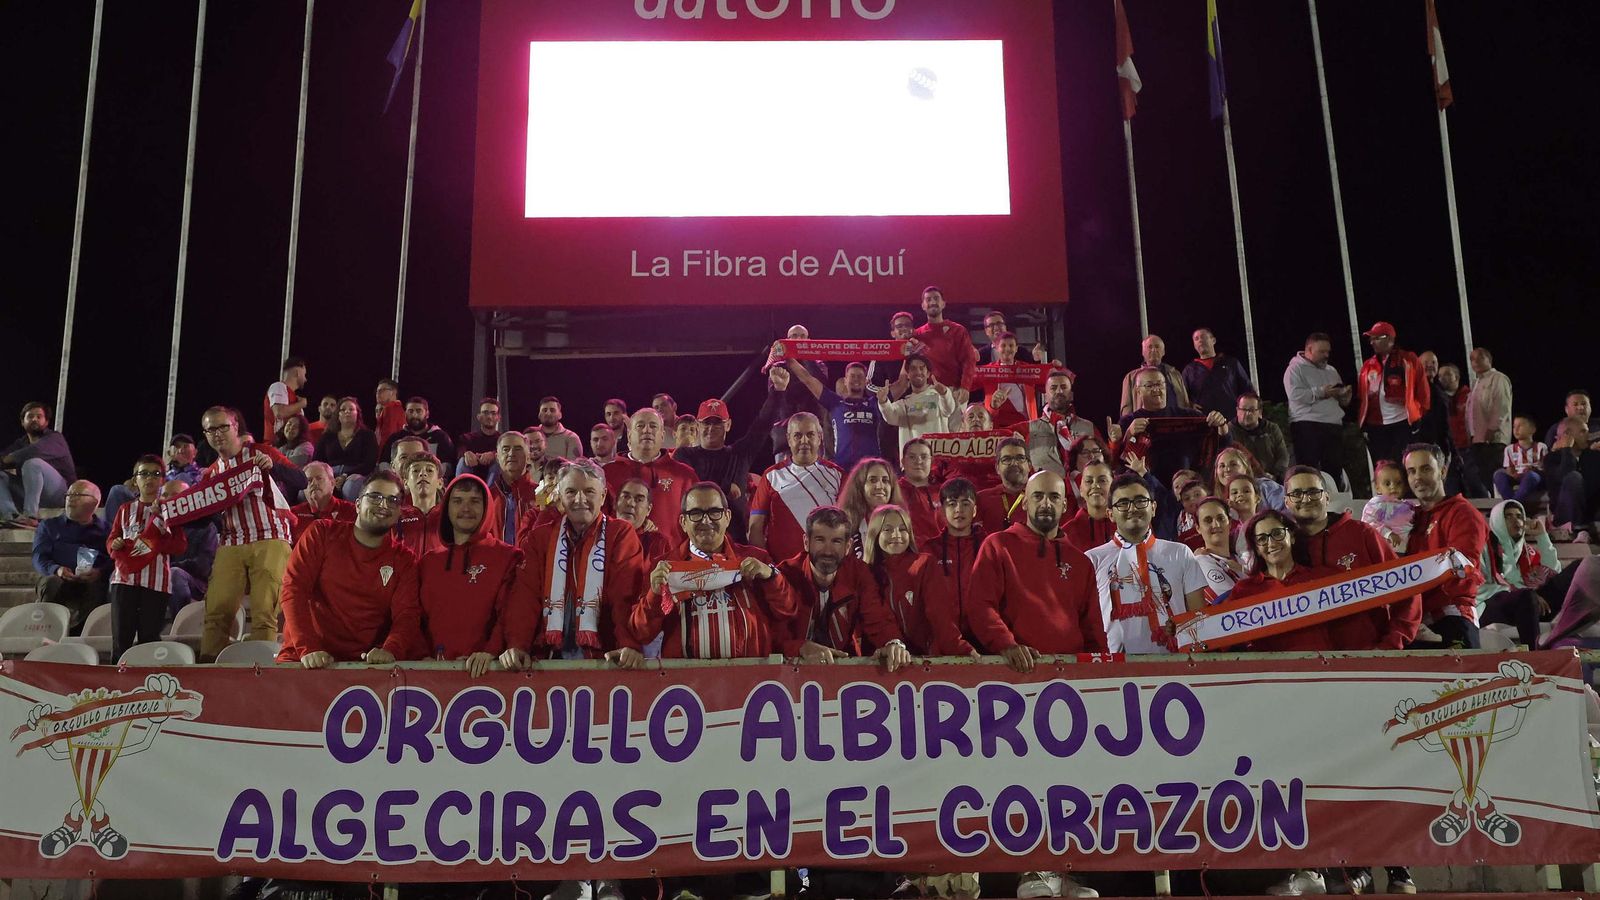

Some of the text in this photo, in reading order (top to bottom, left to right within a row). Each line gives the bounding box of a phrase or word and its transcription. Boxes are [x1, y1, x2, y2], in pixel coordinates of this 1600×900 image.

[631, 248, 906, 283] La Fibra de Aquí
[228, 469, 252, 487] CLUB
[1221, 564, 1423, 632] ORGULLO ALBIRROJO
[53, 701, 160, 733] ORGULLO ALBIRROJO
[325, 683, 1206, 764] ORGULLO ALBIRROJO
[1424, 688, 1518, 725] ORGULLO ALBIRROJO
[217, 757, 1307, 862] ALGECIRAS EN EL CORAZÓN
